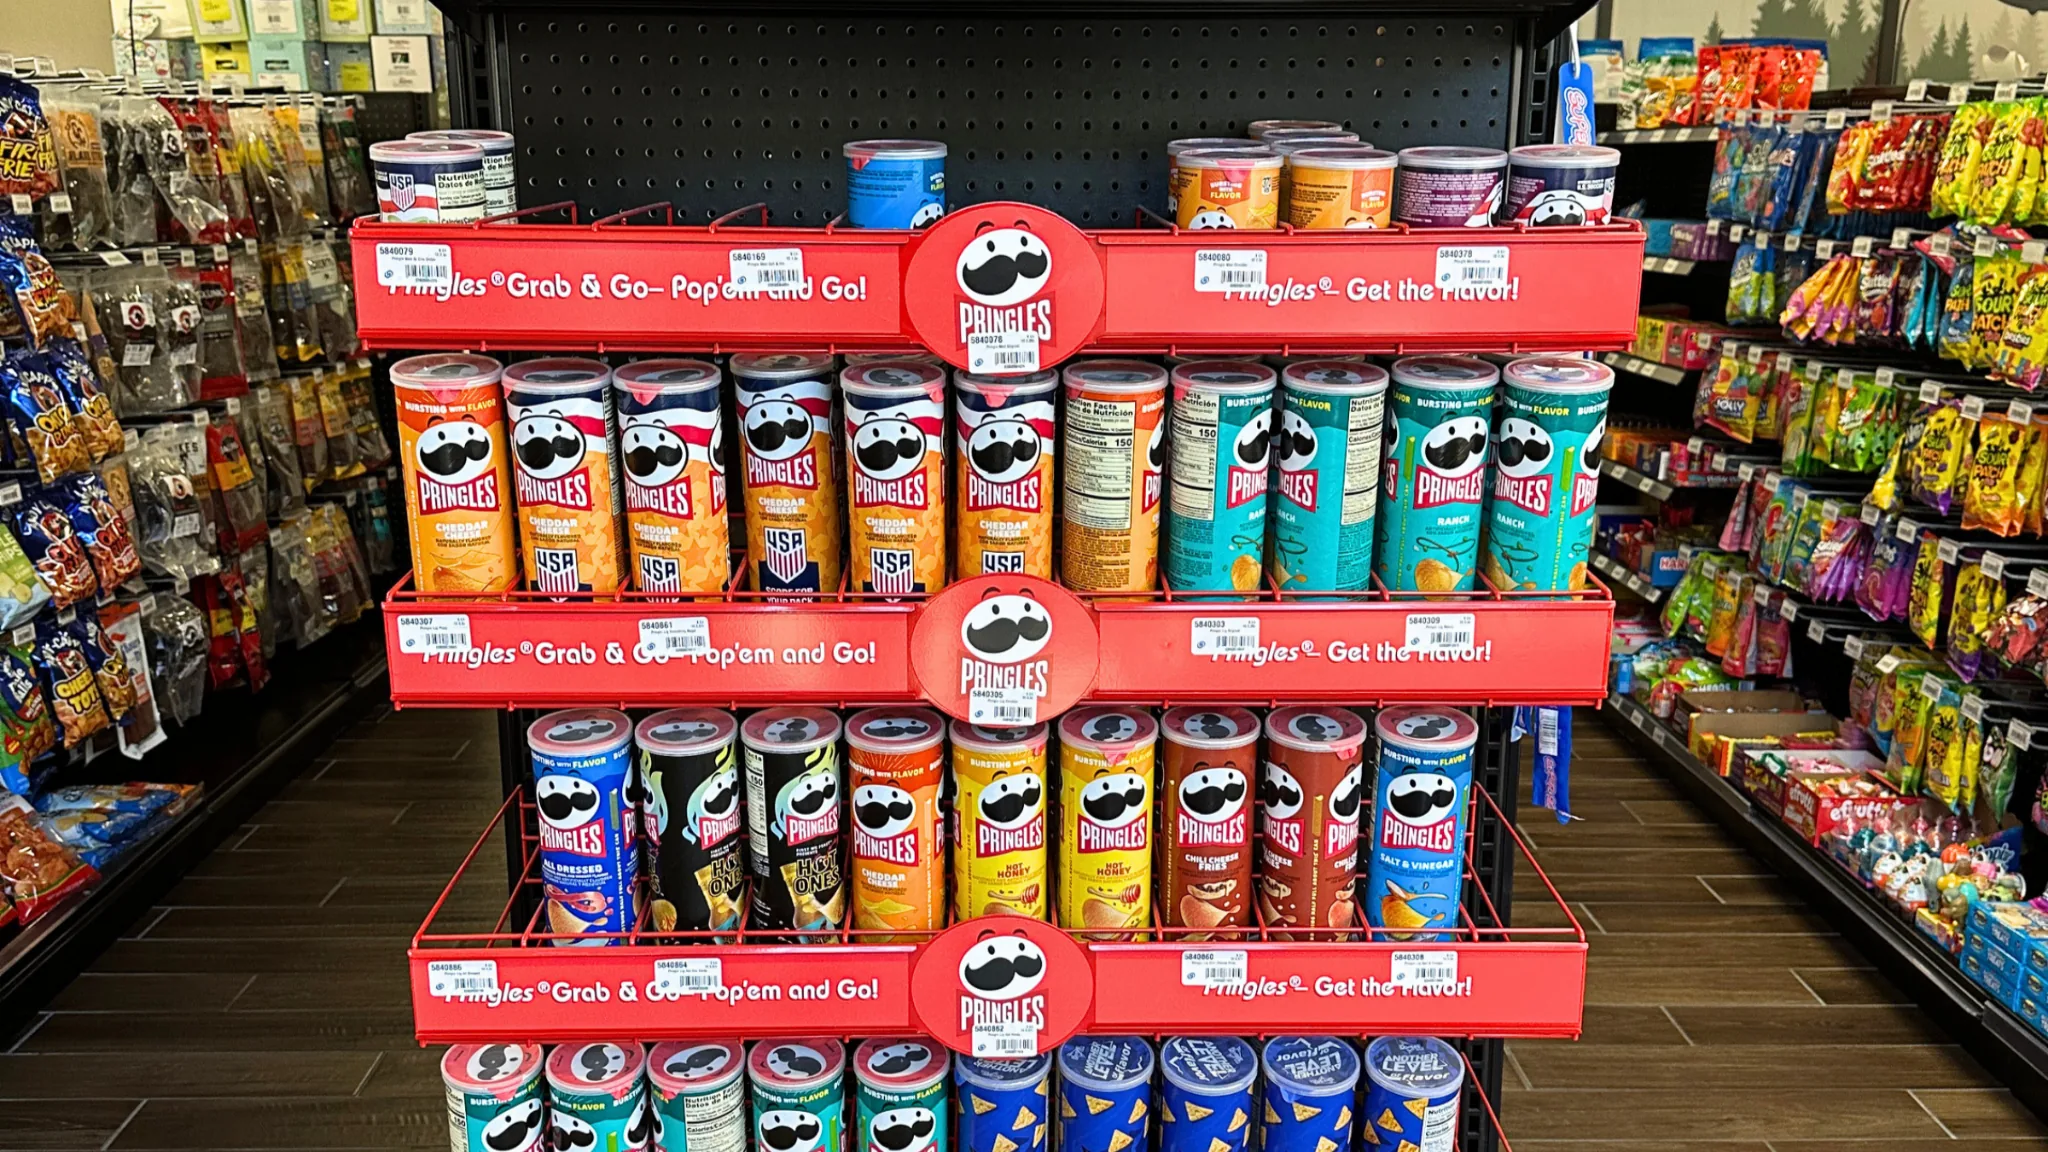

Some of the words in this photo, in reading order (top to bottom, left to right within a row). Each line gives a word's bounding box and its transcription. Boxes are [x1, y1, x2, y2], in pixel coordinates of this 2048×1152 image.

[390, 173, 413, 191] USA
[1210, 191, 1242, 199] FLAVOR
[379, 246, 414, 256] 5840079
[732, 252, 766, 262] 5840169
[507, 272, 572, 298] Grab
[580, 273, 603, 298] &
[821, 276, 867, 301] Go!
[1346, 277, 1391, 301] Get
[1398, 277, 1434, 301] the
[959, 299, 1051, 343] PRINGLES
[404, 401, 448, 414] BURSTING
[467, 398, 497, 412] FLAVOR
[1094, 402, 1117, 410] Facts
[1226, 394, 1266, 407] BURSTING
[1299, 399, 1331, 411] FLAVOR
[1417, 398, 1461, 409] BURSTING
[1533, 405, 1569, 416] FLAVOR
[1199, 429, 1217, 438] 150
[1115, 438, 1132, 447] 150
[748, 457, 814, 486] PRINGLES
[419, 473, 497, 511] PRINGLES
[518, 468, 588, 507] PRINGLES
[856, 471, 924, 506] PRINGLES
[968, 476, 1038, 509] PRINGLES
[1418, 470, 1483, 504] PRINGLES
[626, 480, 689, 516] PRINGLES
[758, 497, 805, 507] CHEDDAR
[435, 520, 488, 532] CHEDDAR
[529, 516, 578, 527] CHEDDAR
[866, 517, 915, 527] CHEDDAR
[980, 520, 1028, 531] CHEDDAR
[1437, 515, 1470, 526] RANCH
[1496, 512, 1525, 530] RANCH
[444, 530, 481, 540] CHEESE
[634, 523, 679, 535] CHEDDAR
[766, 530, 801, 553] USA
[536, 549, 574, 573] USA
[641, 553, 677, 582] USA
[874, 549, 911, 574] USA
[984, 553, 1022, 573] USA
[400, 617, 433, 627] 5840307
[1409, 616, 1440, 625] 5840309
[534, 641, 596, 665] Grab
[605, 642, 626, 665] &
[782, 641, 825, 665] and
[832, 641, 876, 665] Go!
[1327, 640, 1370, 663] Get
[1376, 640, 1411, 663] the
[960, 656, 1049, 698] PRINGLES
[572, 756, 607, 769] FLAVOR
[970, 758, 1011, 769] BURSTING
[1384, 749, 1421, 766] BURSTING
[1439, 753, 1466, 766] FLAVOR
[892, 766, 924, 778] FLAVOR
[789, 807, 839, 842] PRINGLES
[1080, 816, 1145, 849] PRINGLES
[1179, 812, 1244, 844] PRINGLES
[1383, 814, 1453, 850] PRINGLES
[539, 823, 601, 855] PRINGLES
[979, 815, 1043, 854] PRINGLES
[854, 827, 915, 864] PRINGLES
[796, 848, 838, 878] HOT
[1185, 853, 1207, 863] CHILI
[1208, 852, 1239, 863] CHEESE
[1380, 852, 1401, 867] SALT
[1402, 860, 1410, 868] &
[1411, 858, 1454, 870] VINEGAR
[557, 864, 603, 874] DRESSED
[997, 866, 1031, 879] HONEY
[1006, 862, 1023, 871] HOT
[1096, 866, 1132, 876] HONEY
[1105, 862, 1123, 871] HOT
[1198, 861, 1227, 871] FRIES
[793, 865, 840, 896] ONES
[862, 868, 905, 881] CHEDDAR
[551, 981, 610, 1003] Grab
[619, 981, 638, 1002] &
[788, 979, 830, 1001] and
[836, 978, 879, 1000] Go!
[1314, 976, 1356, 997] Get
[1362, 976, 1395, 997] the
[960, 994, 1045, 1032] PRINGLES
[1385, 1052, 1439, 1062] ANOTHER
[1382, 1059, 1444, 1073] LEVEL
[799, 1089, 829, 1104] FLAVOR
[864, 1087, 900, 1102] BURSTING
[916, 1083, 942, 1100] FLAVOR
[573, 1102, 606, 1111] FLAVOR
